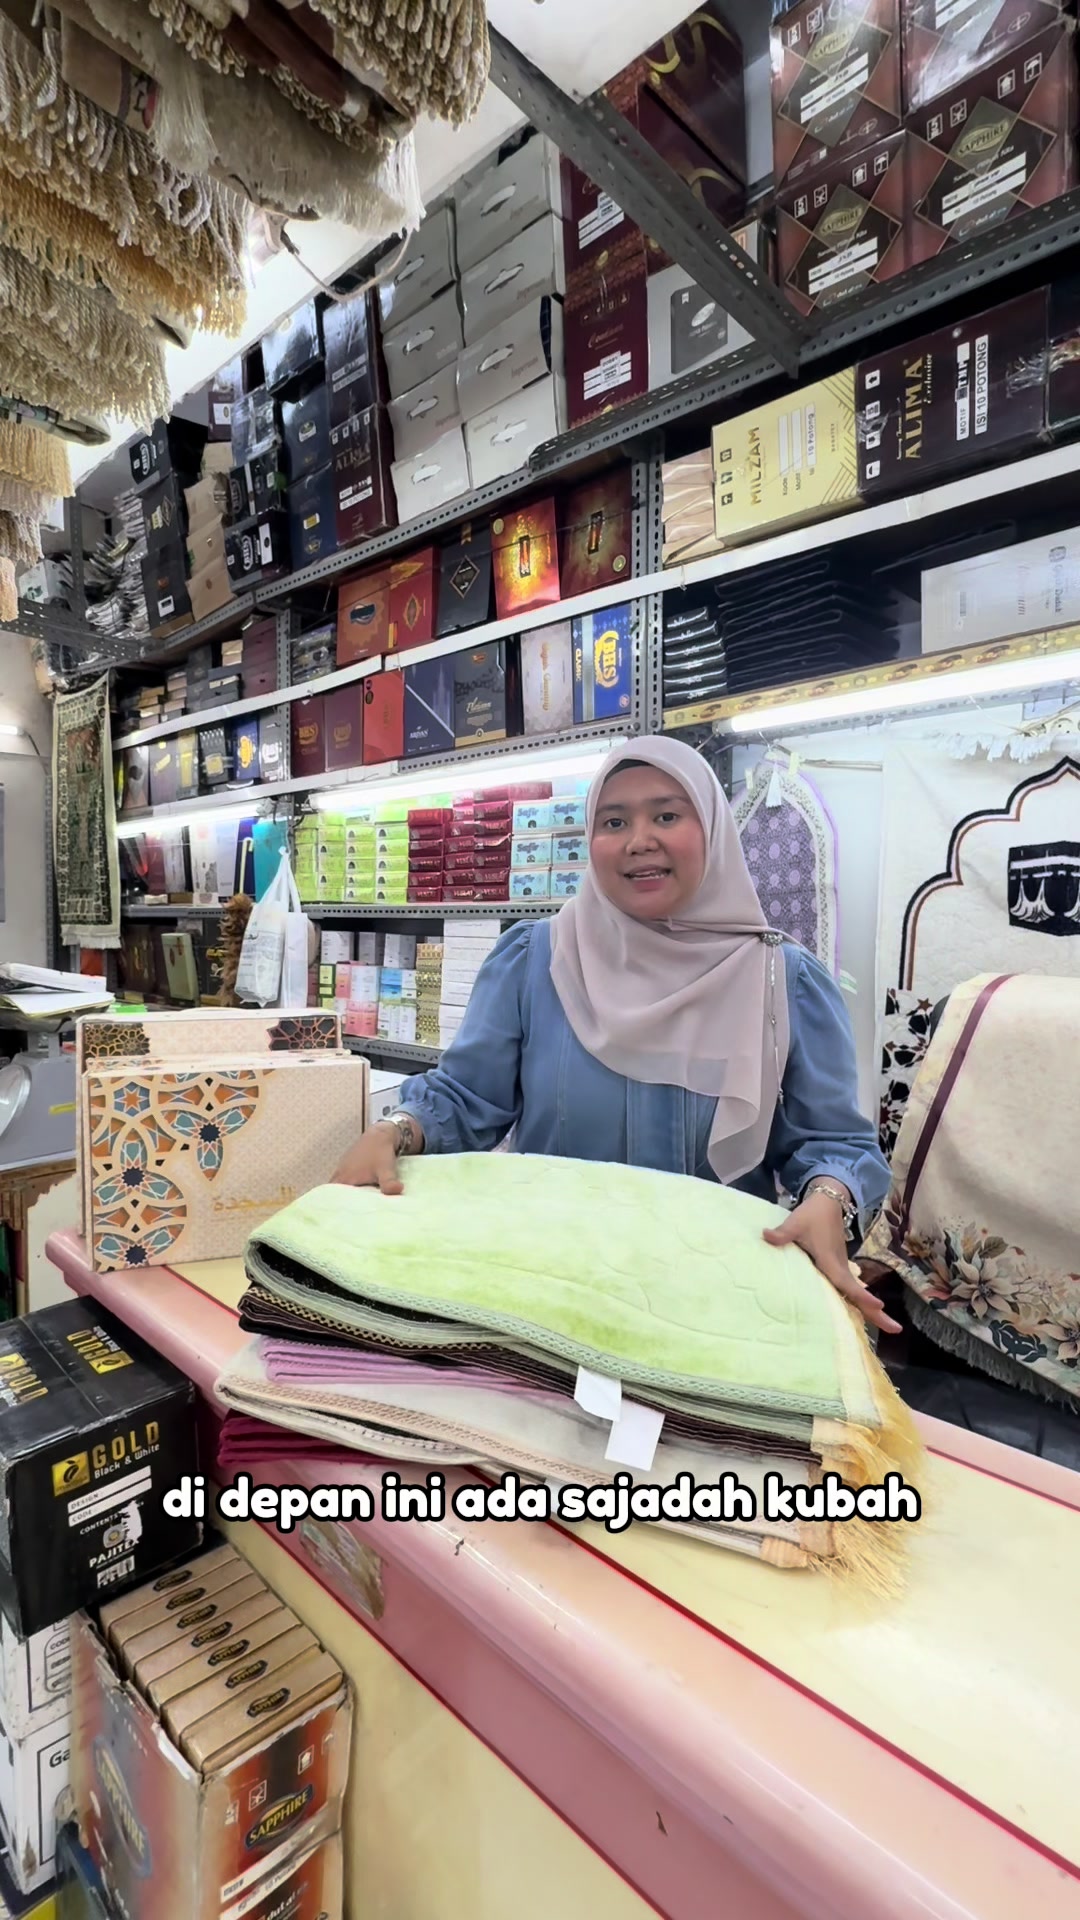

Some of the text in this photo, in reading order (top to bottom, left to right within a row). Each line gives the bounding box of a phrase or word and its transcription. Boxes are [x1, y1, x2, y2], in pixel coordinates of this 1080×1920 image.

[958, 121, 1009, 156] SAPPHIRE
[976, 341, 988, 429] ISI 10 POTONG
[905, 357, 923, 459] ALIMA
[807, 412, 816, 445] Potong
[748, 426, 762, 507] MILZAM
[66, 1329, 110, 1360] GOLD
[92, 1421, 160, 1469] GOLD
[94, 1443, 160, 1479] Black & White
[71, 1493, 99, 1510] DESIGN
[72, 1509, 92, 1523] CODE
[89, 1537, 140, 1569] PAJITEX
[249, 1789, 310, 1844] SAPPHIRE
